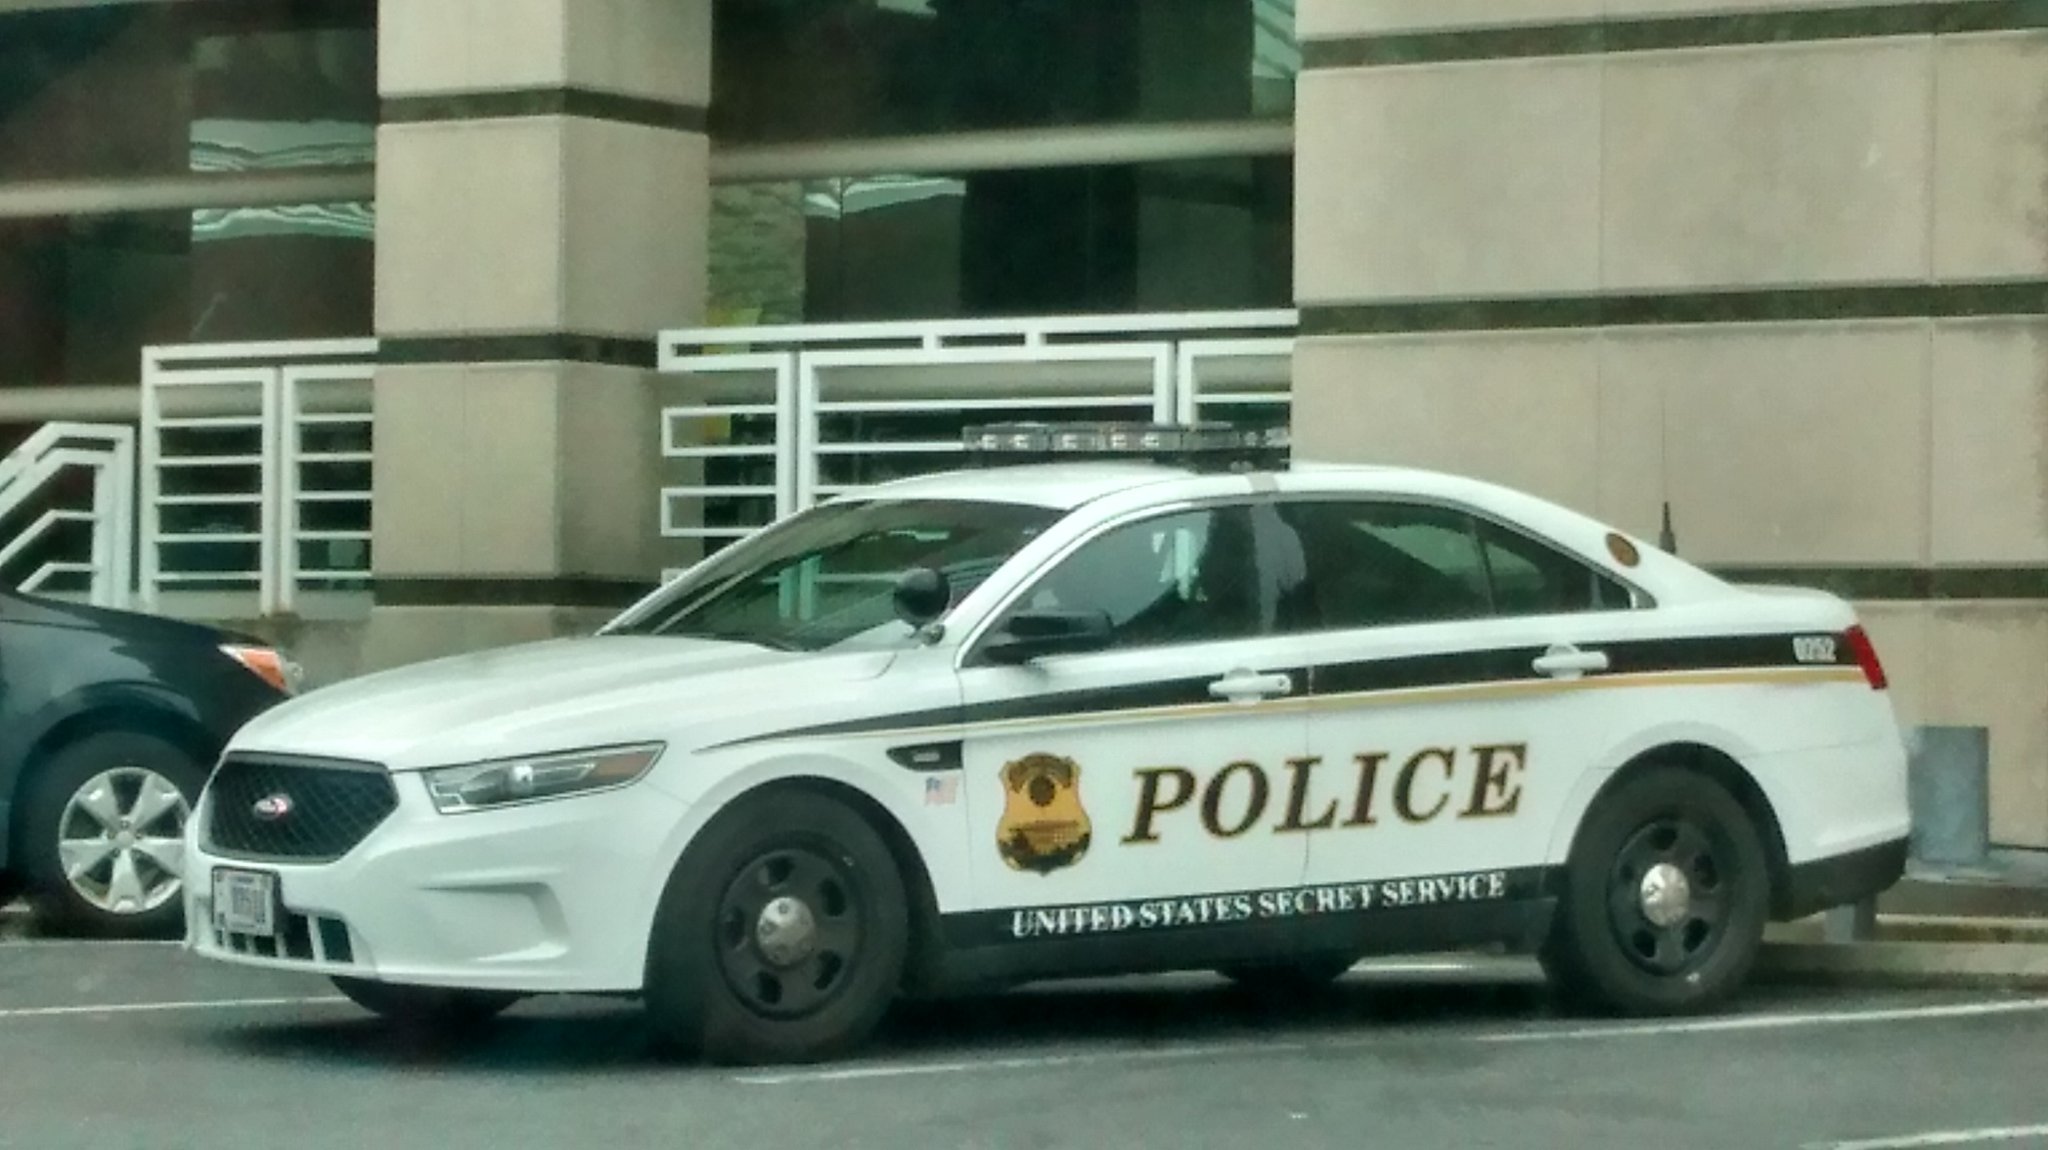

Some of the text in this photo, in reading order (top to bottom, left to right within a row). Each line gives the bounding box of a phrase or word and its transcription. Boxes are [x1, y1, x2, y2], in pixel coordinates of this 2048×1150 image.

[1119, 742, 1527, 846] POLICE
[1012, 871, 1506, 938] UNITED STATES SECRET SERVICE
